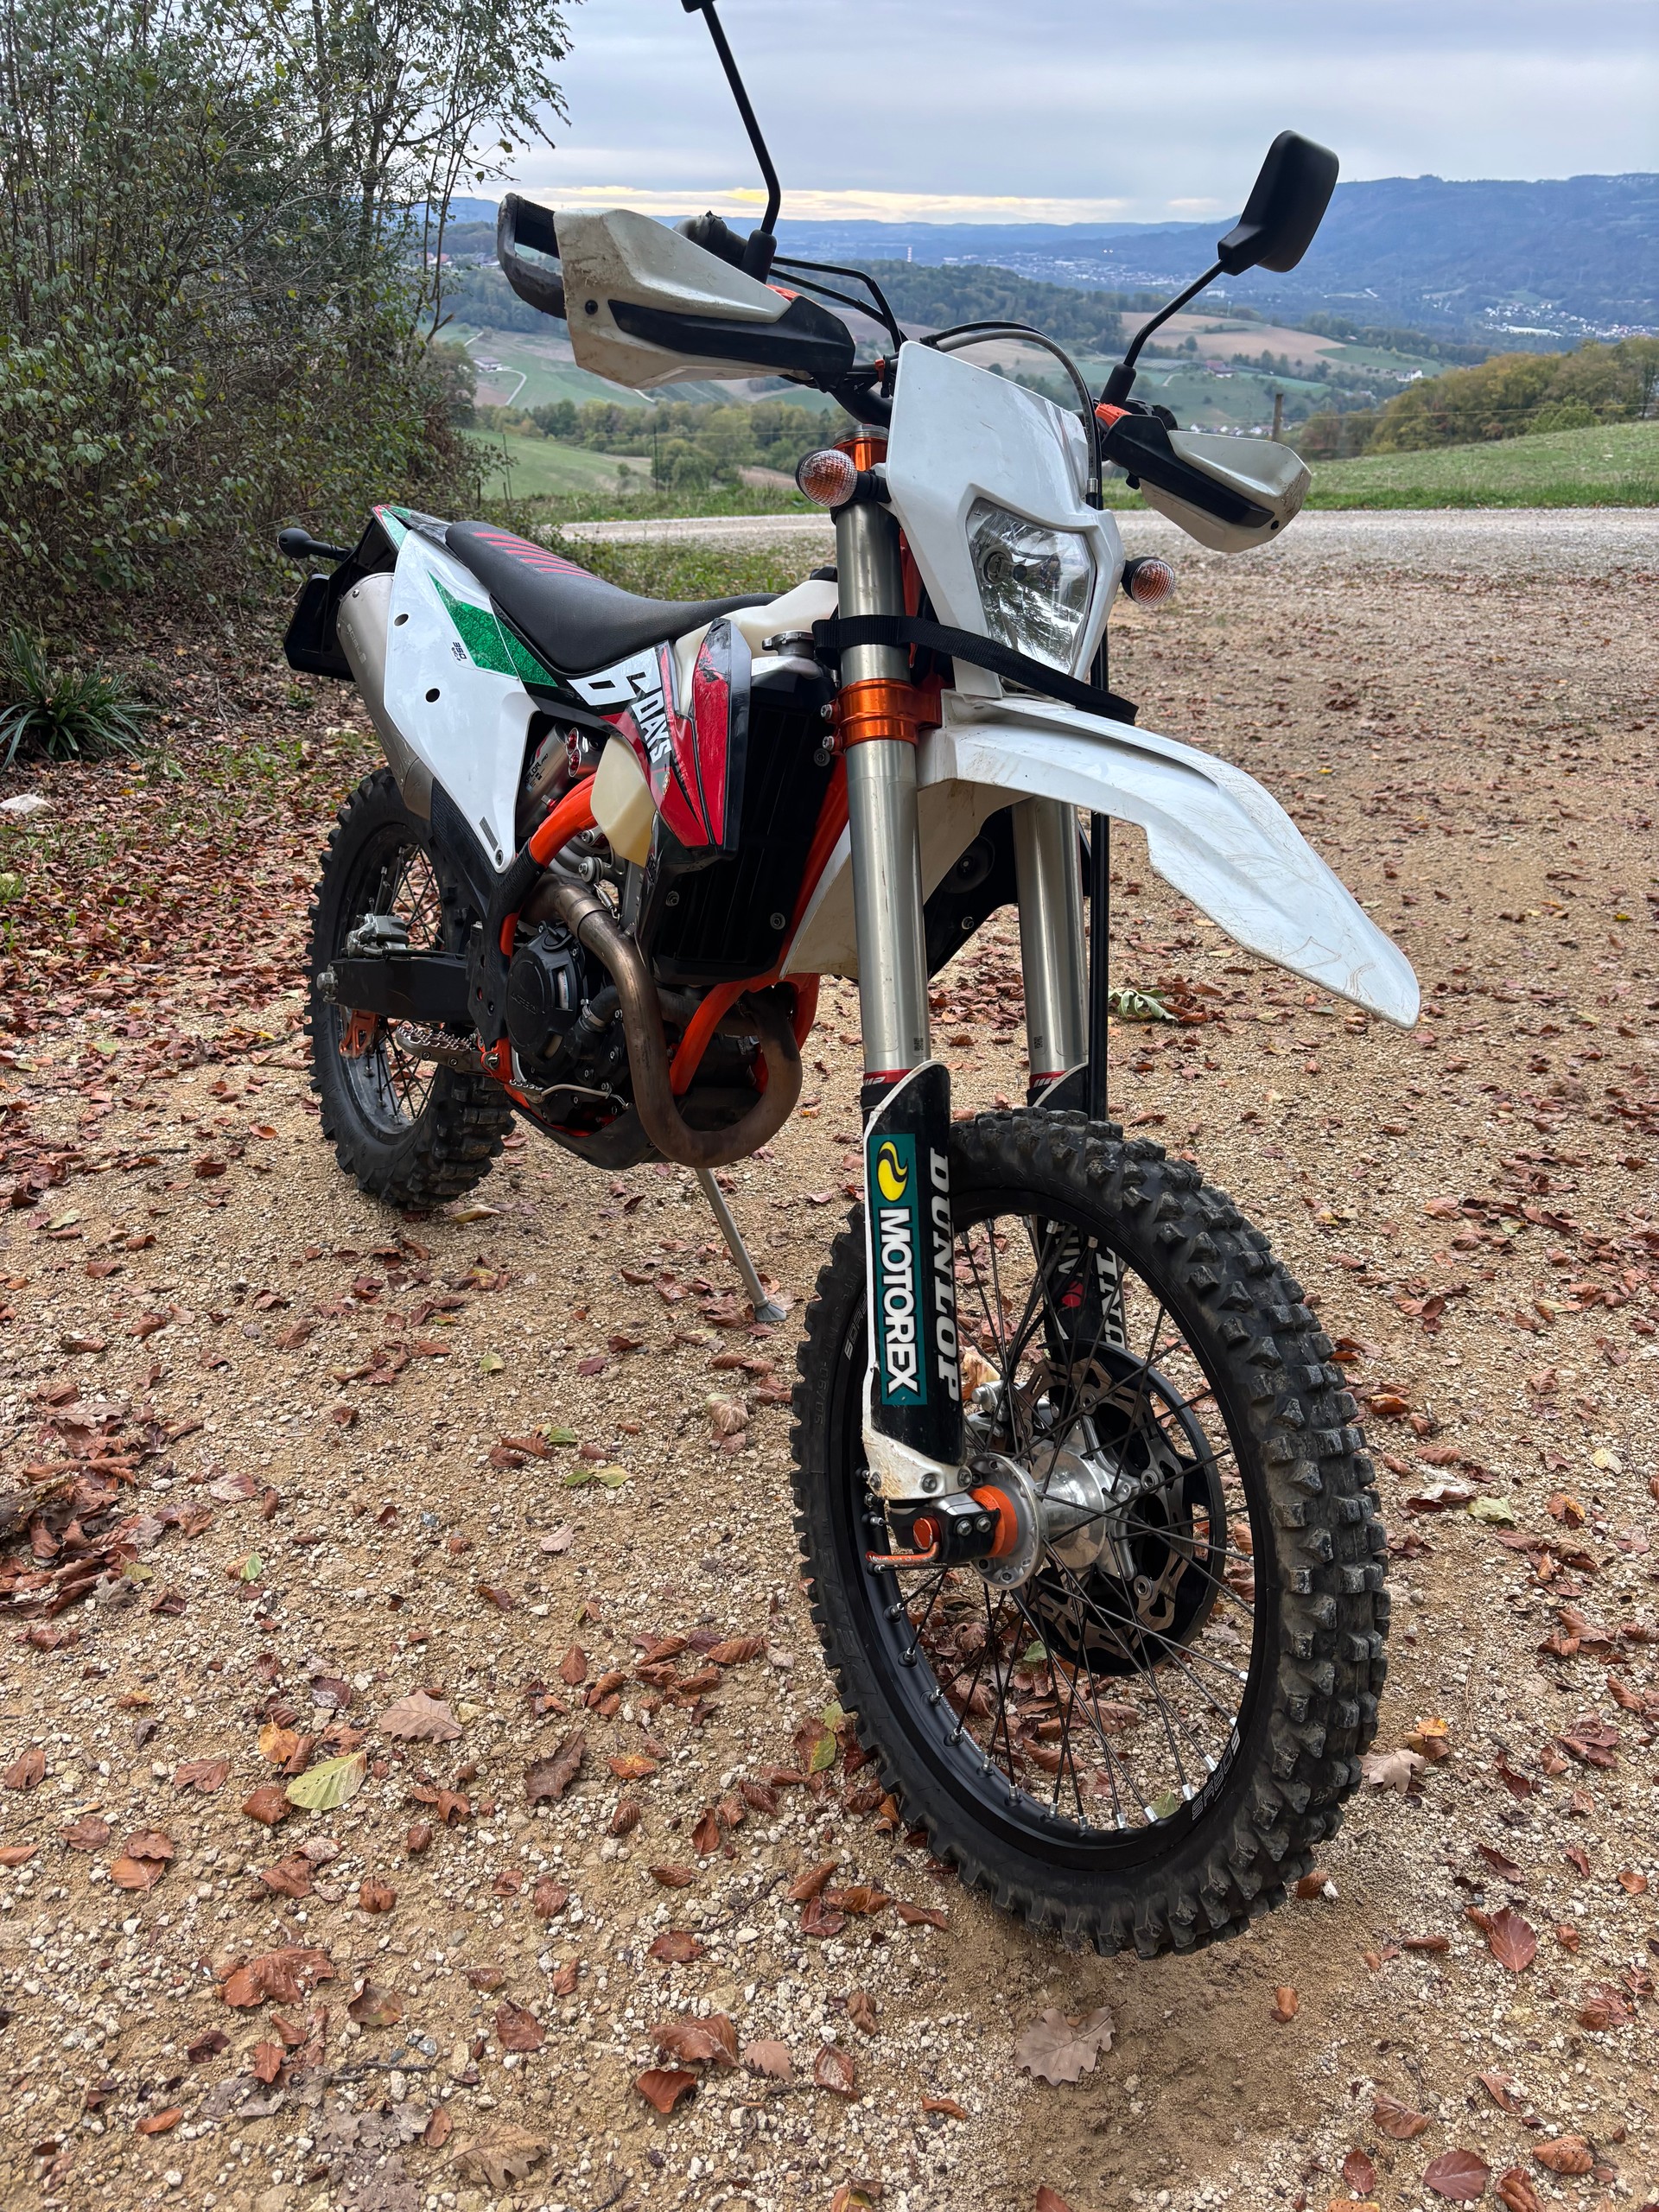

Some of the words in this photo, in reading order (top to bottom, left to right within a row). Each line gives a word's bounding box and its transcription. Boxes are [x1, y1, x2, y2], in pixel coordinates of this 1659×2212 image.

[453, 642, 467, 659] 350
[631, 690, 671, 764] DAYS
[880, 1208, 918, 1394] MOTOREX
[930, 1147, 960, 1402] DUNLOP
